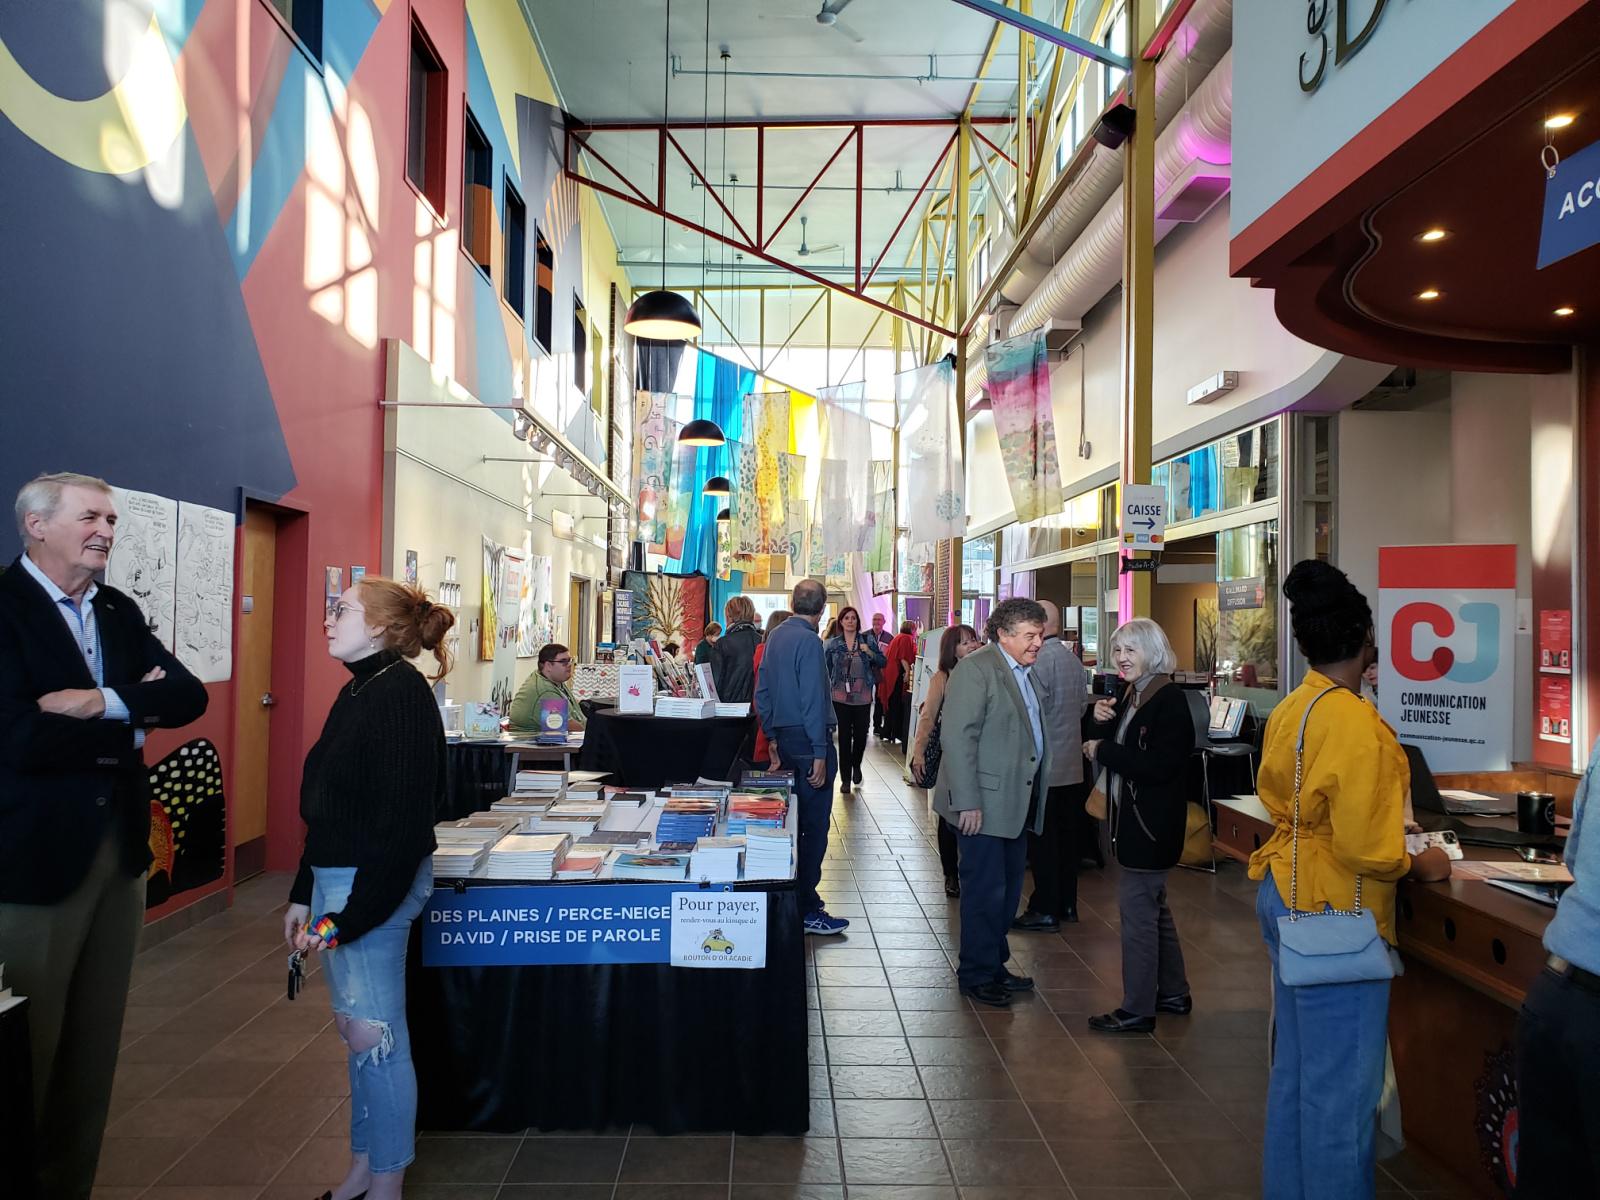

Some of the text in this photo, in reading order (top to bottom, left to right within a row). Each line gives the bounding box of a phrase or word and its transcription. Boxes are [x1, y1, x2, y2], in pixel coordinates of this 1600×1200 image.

[1127, 504, 1161, 516] CAISSE
[1401, 692, 1486, 710] COMMUNICATION
[1401, 709, 1451, 725] JEUNESSE
[430, 906, 670, 924] DES PLAINES / PERCE-NEIGE
[679, 897, 760, 915] Pour payer,
[440, 928, 661, 946] DAVID / PRISE DE PAROLE
